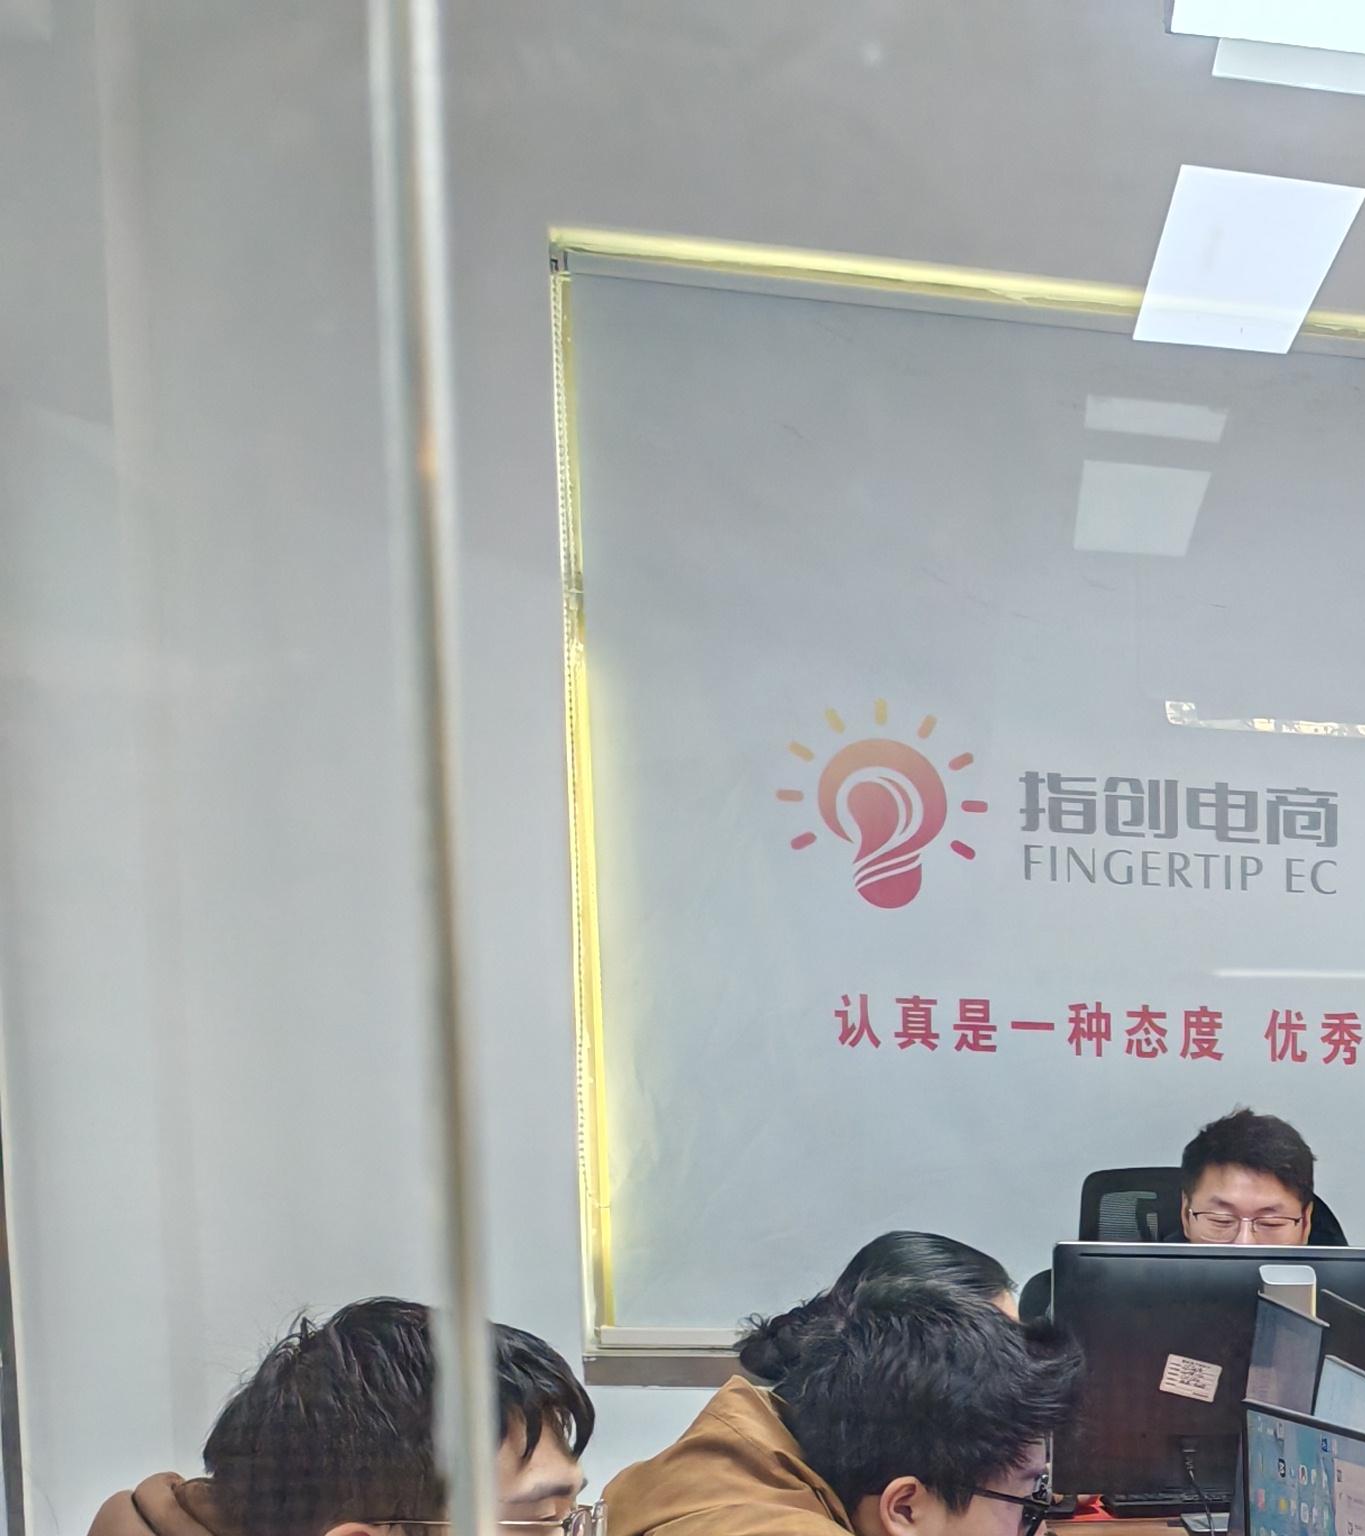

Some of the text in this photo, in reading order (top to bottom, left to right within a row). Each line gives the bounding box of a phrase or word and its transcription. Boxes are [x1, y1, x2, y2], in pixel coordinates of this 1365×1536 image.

[1019, 771, 1338, 847] 指创电商
[1024, 844, 1337, 894] FINGERTIP EC
[834, 993, 1225, 1060] 认真是一种态度
